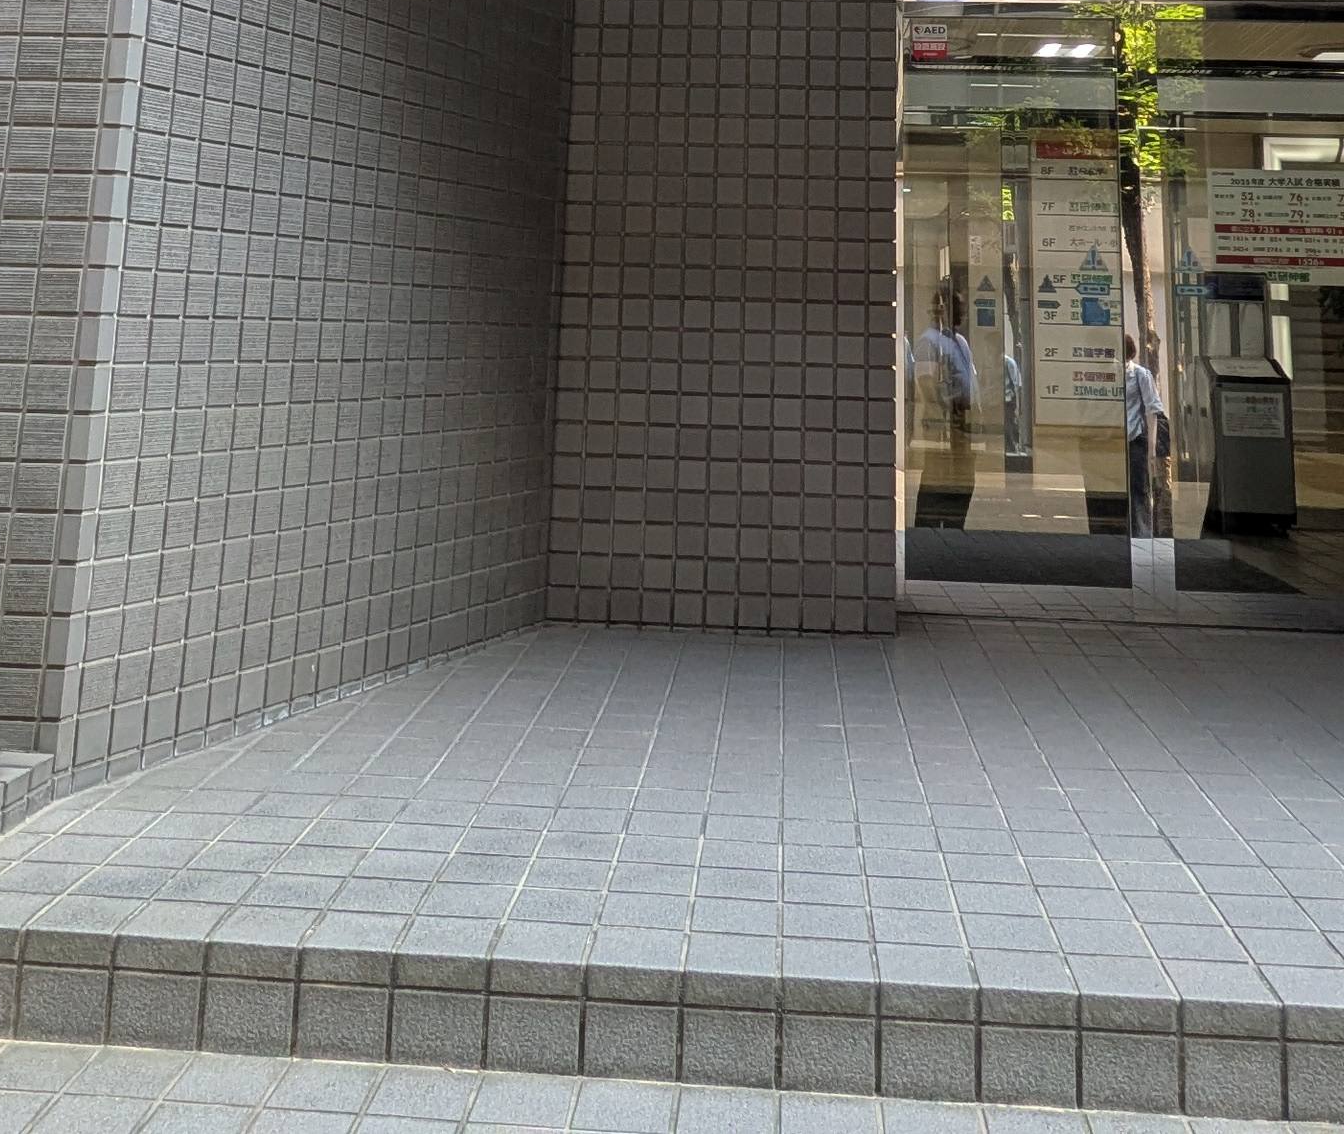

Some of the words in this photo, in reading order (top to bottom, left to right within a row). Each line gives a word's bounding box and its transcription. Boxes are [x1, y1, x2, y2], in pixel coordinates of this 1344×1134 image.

[923, 26, 946, 35] AED
[1041, 202, 1056, 211] 7F
[1042, 237, 1056, 247] 6F
[1053, 274, 1067, 284] 5F
[1043, 311, 1058, 321] 3F
[1044, 348, 1059, 357] 2F
[1046, 386, 1059, 395] 1F
